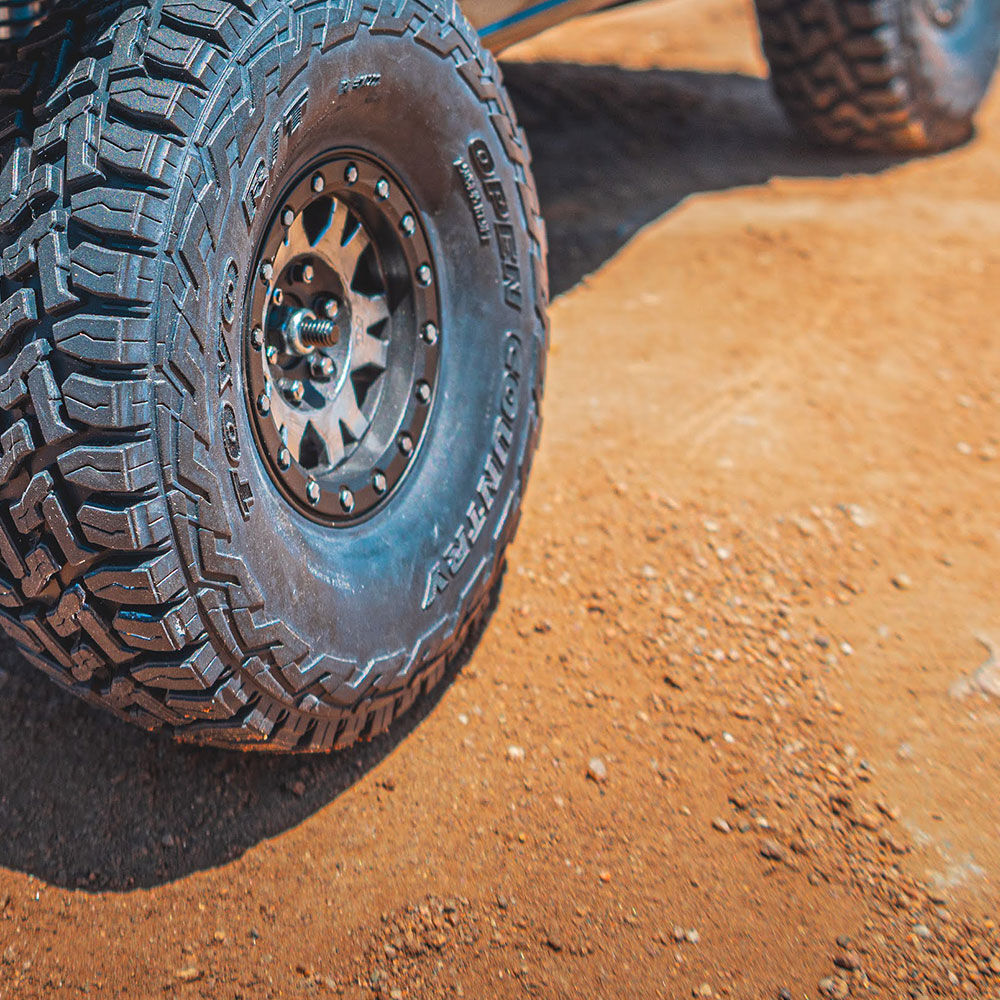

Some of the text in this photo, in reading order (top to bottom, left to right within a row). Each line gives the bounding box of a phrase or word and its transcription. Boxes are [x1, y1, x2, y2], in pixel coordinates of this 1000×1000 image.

[468, 138, 522, 313] OPEN
[218, 256, 254, 522] TOYO
[420, 331, 522, 609] COUNTRY
